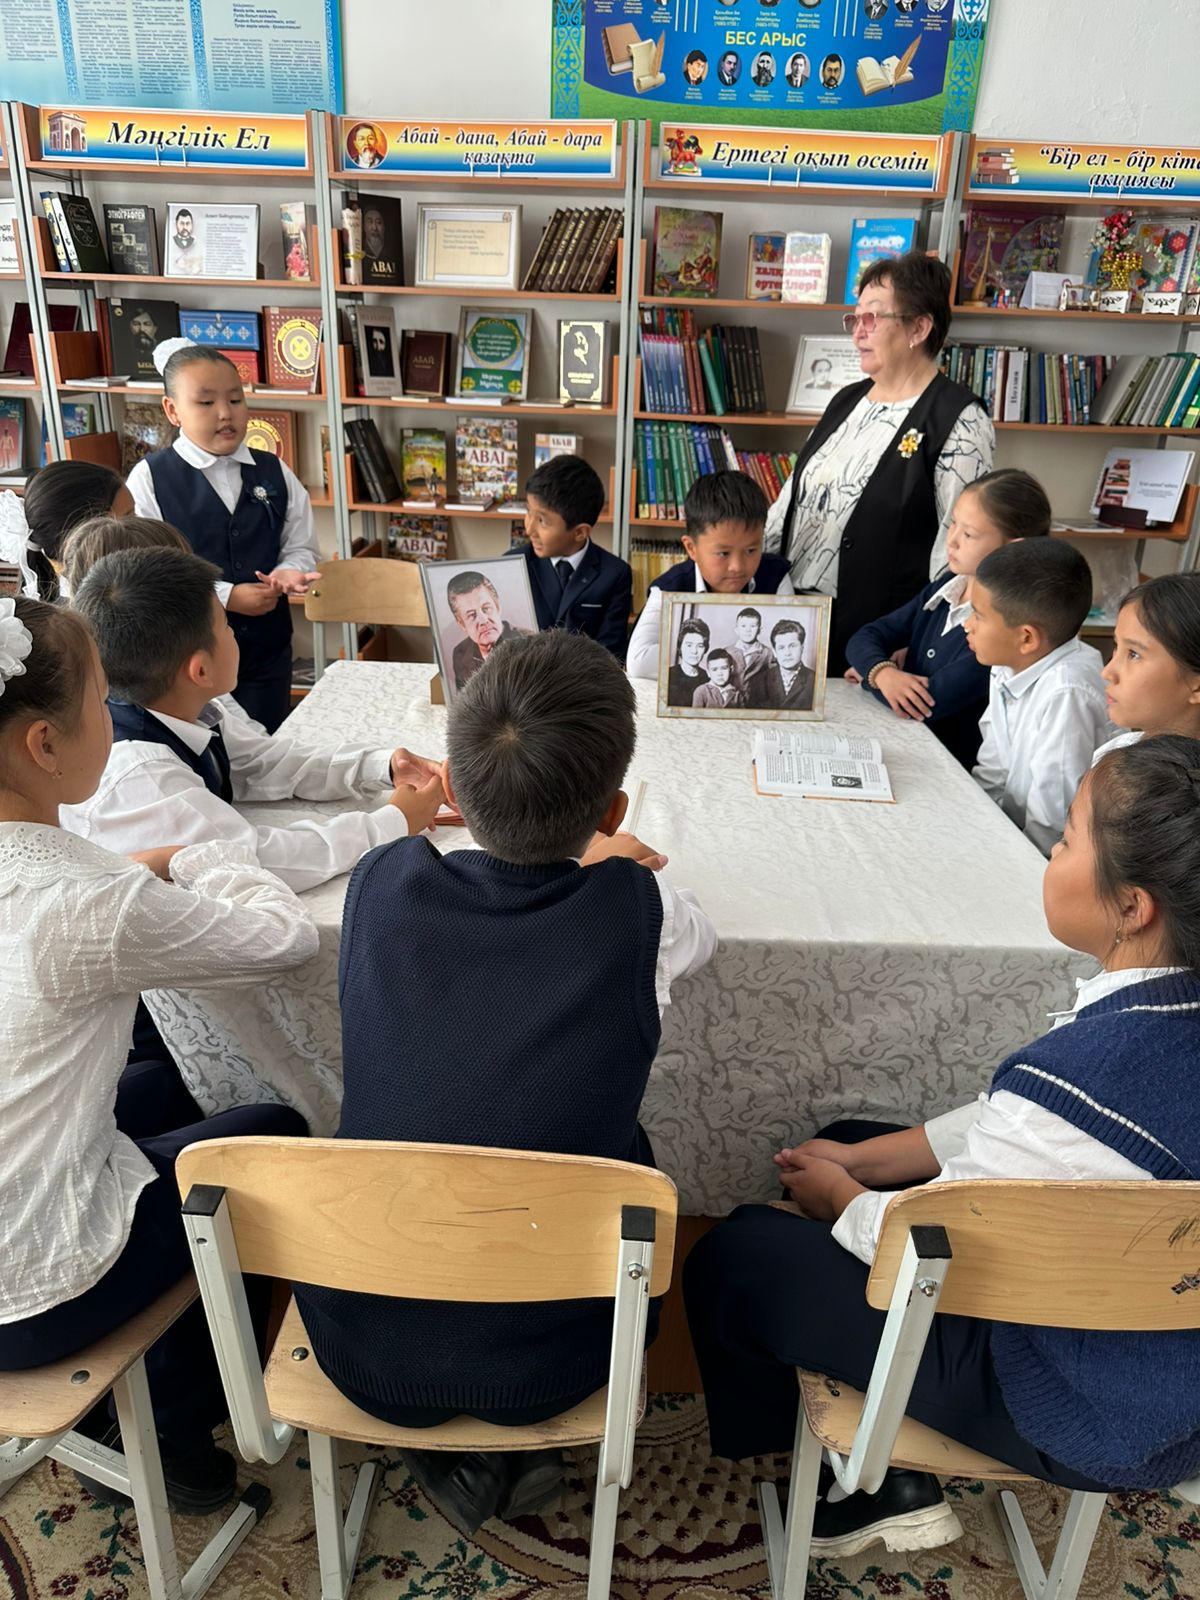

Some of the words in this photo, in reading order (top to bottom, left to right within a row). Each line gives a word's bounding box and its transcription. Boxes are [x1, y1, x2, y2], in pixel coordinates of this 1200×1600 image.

[725, 31, 756, 46] БЕС
[760, 32, 807, 47] АРЫС
[107, 121, 227, 150] Мәңгілік
[234, 127, 271, 150] Ел
[397, 128, 439, 144] Абай
[456, 130, 500, 148] дана,
[505, 129, 547, 147] Абай
[564, 131, 602, 150] дара
[712, 142, 789, 164] Ертегі
[794, 151, 850, 170] оқып
[857, 151, 929, 171] өсемін
[1086, 155, 1107, 166] ел
[1126, 150, 1155, 172] бір
[1090, 173, 1175, 190] акциясы
[470, 449, 505, 464] ABAI
[400, 539, 434, 553] ABAI
